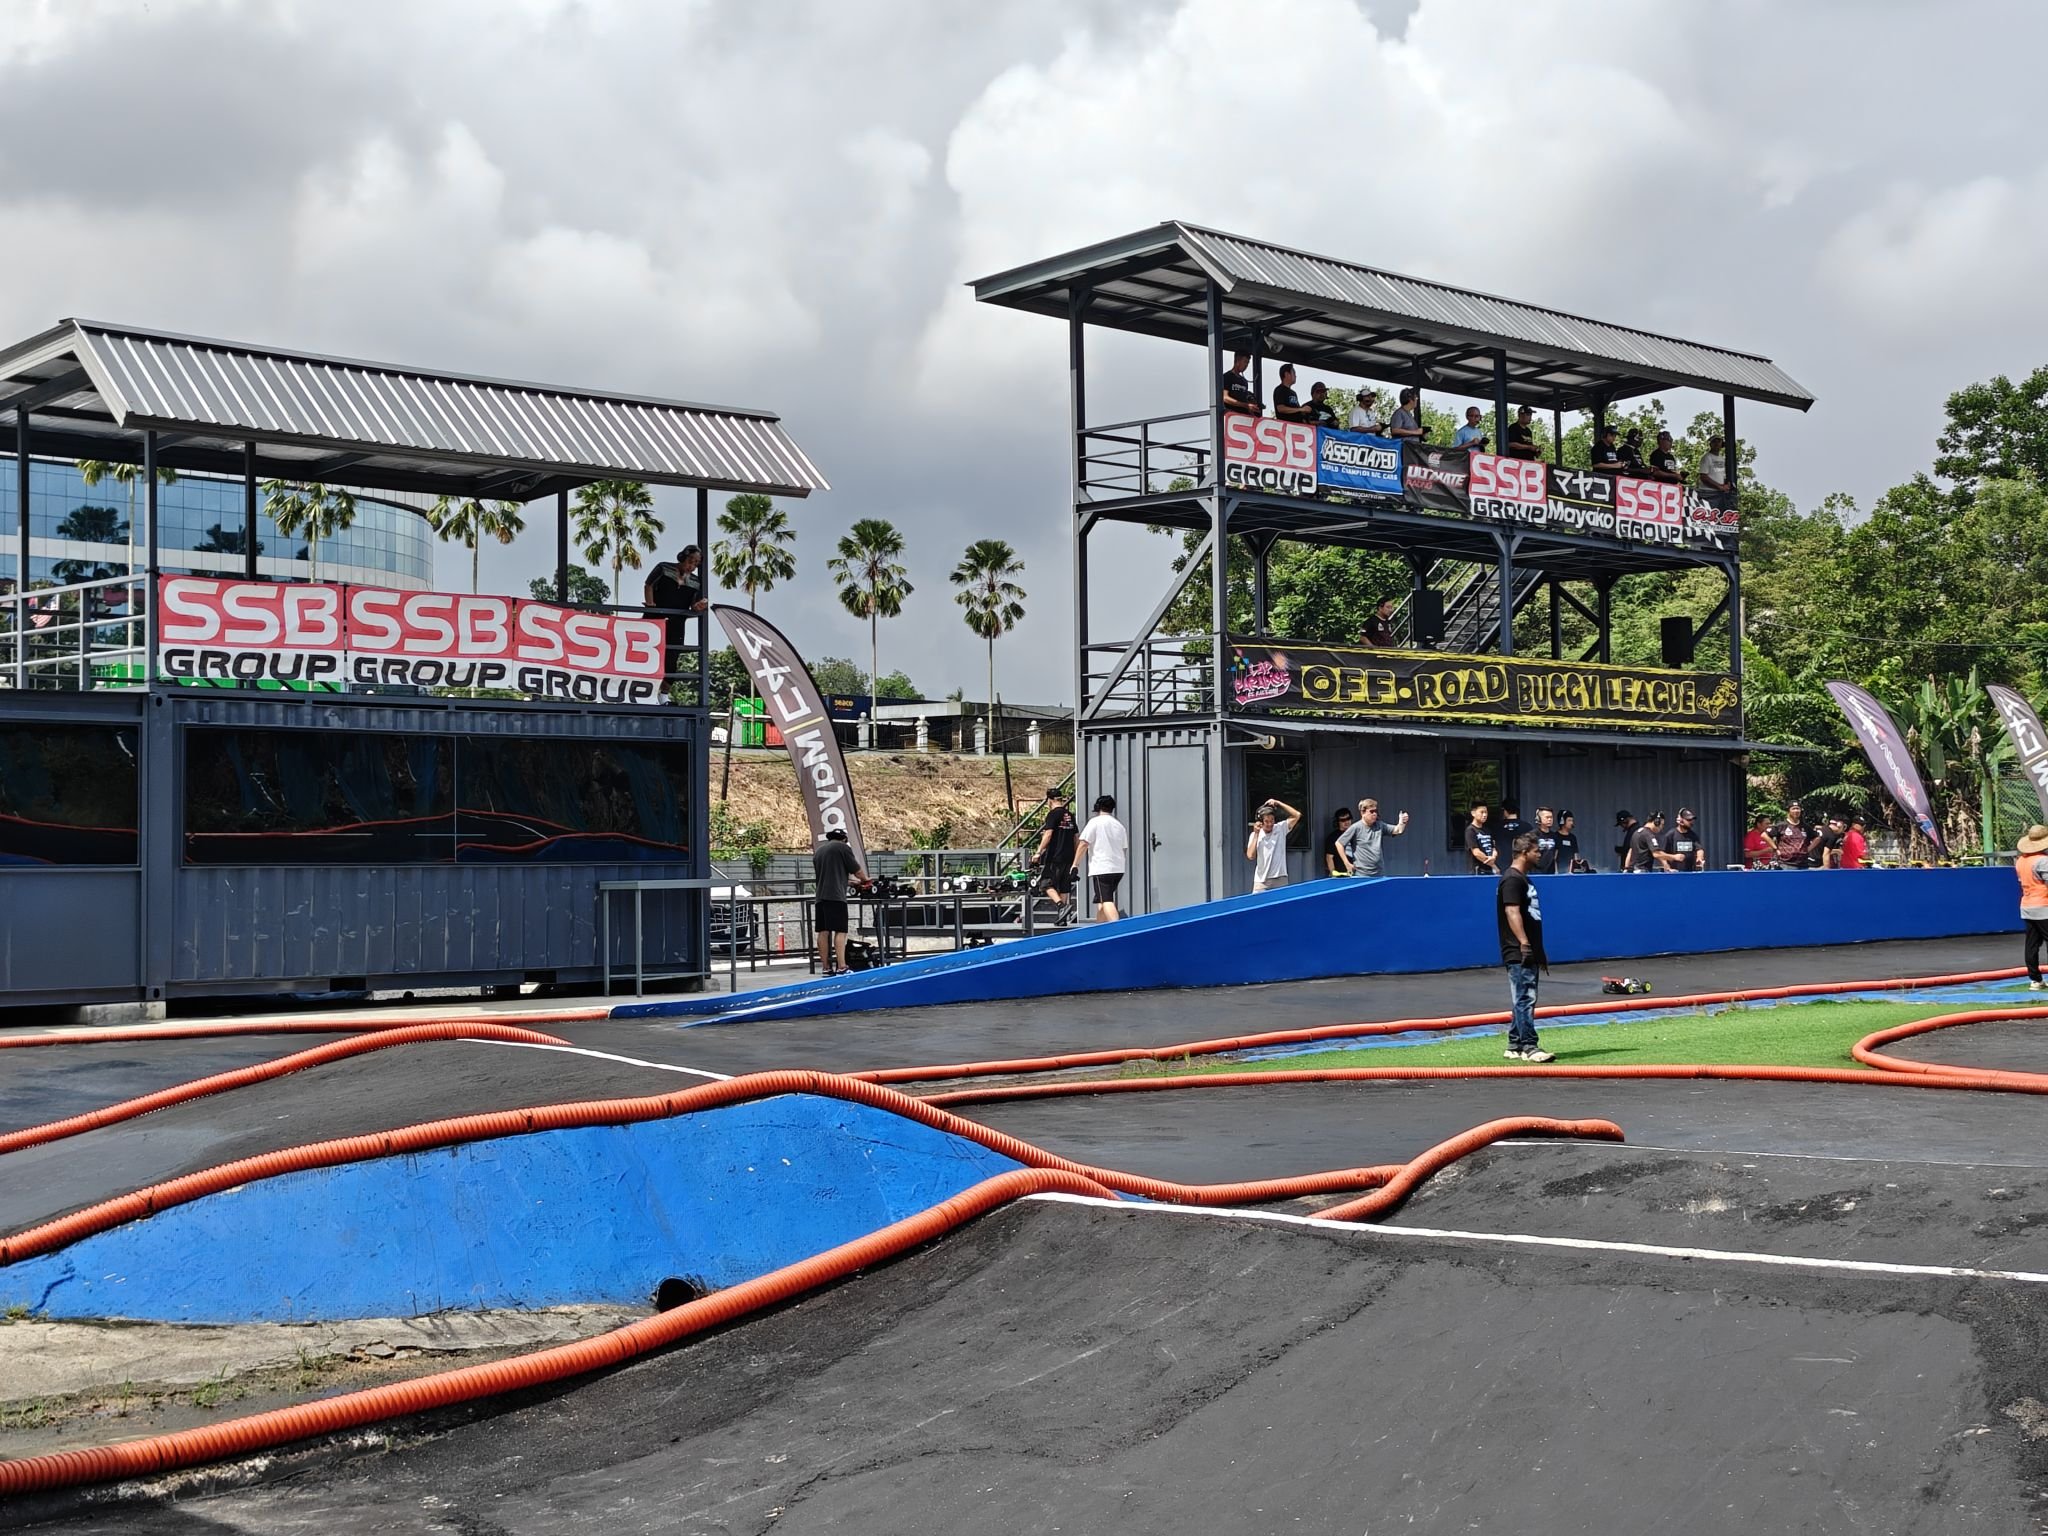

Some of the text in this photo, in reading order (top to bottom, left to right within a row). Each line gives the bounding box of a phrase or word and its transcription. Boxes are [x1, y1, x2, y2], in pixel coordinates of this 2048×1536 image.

[1226, 415, 1316, 469] SSB
[1321, 438, 1396, 470] ASSOCIATED
[1226, 463, 1316, 494] GROUP
[1341, 466, 1370, 477] CHAMPION
[1471, 455, 1546, 501] SSB
[1552, 469, 1611, 501] マヤコ
[1473, 497, 1547, 524] GROUP
[1549, 499, 1614, 530] Mayako
[1617, 479, 1682, 523] SSB
[1618, 519, 1682, 543] GROUP
[163, 578, 339, 645] SSB
[352, 590, 508, 654] SSB
[518, 604, 661, 674] SSB
[164, 648, 337, 680] GROUP
[353, 656, 506, 688] GROUP
[518, 667, 654, 704] GROUP
[1516, 672, 1600, 713] BUGGY
[1606, 676, 1696, 714] LEAGUE
